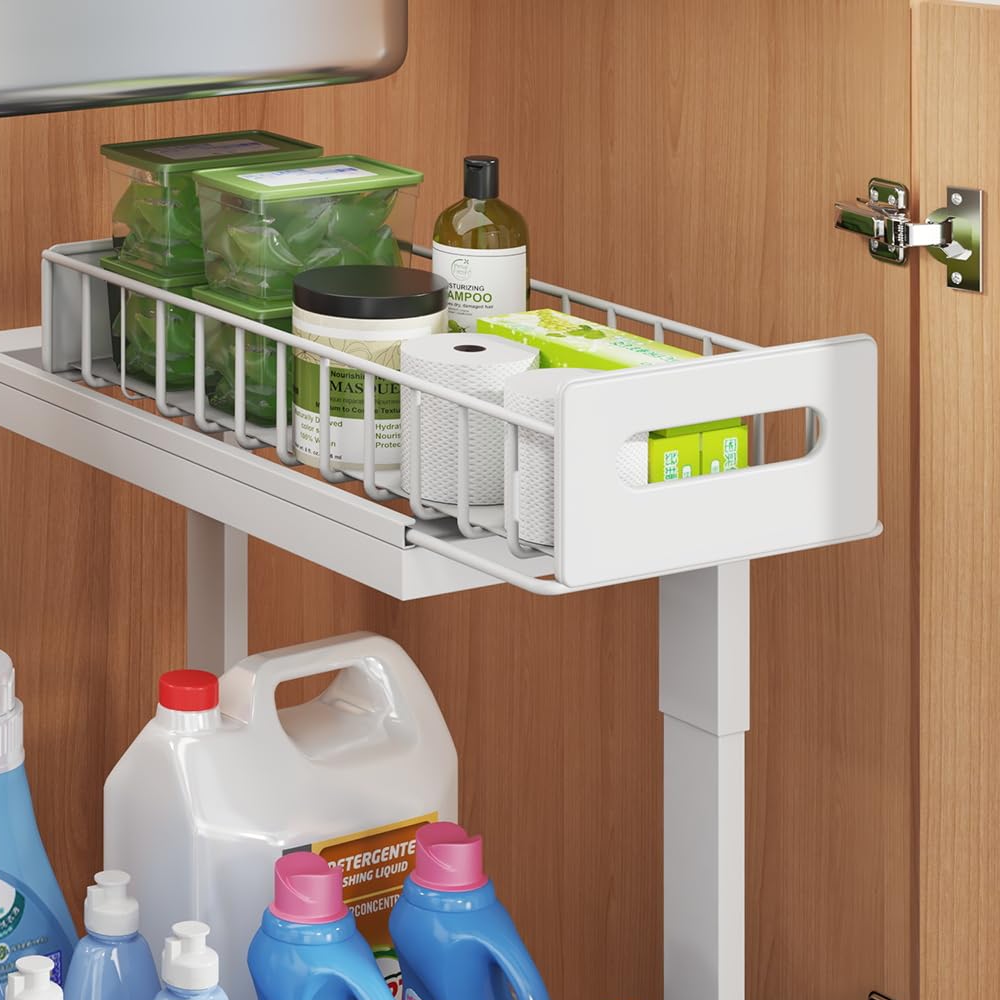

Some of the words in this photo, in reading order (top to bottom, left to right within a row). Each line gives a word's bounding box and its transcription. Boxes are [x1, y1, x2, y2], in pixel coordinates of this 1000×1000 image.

[330, 380, 400, 394] MASUE
[342, 870, 374, 887] SHING
[376, 861, 408, 878] LIQUID
